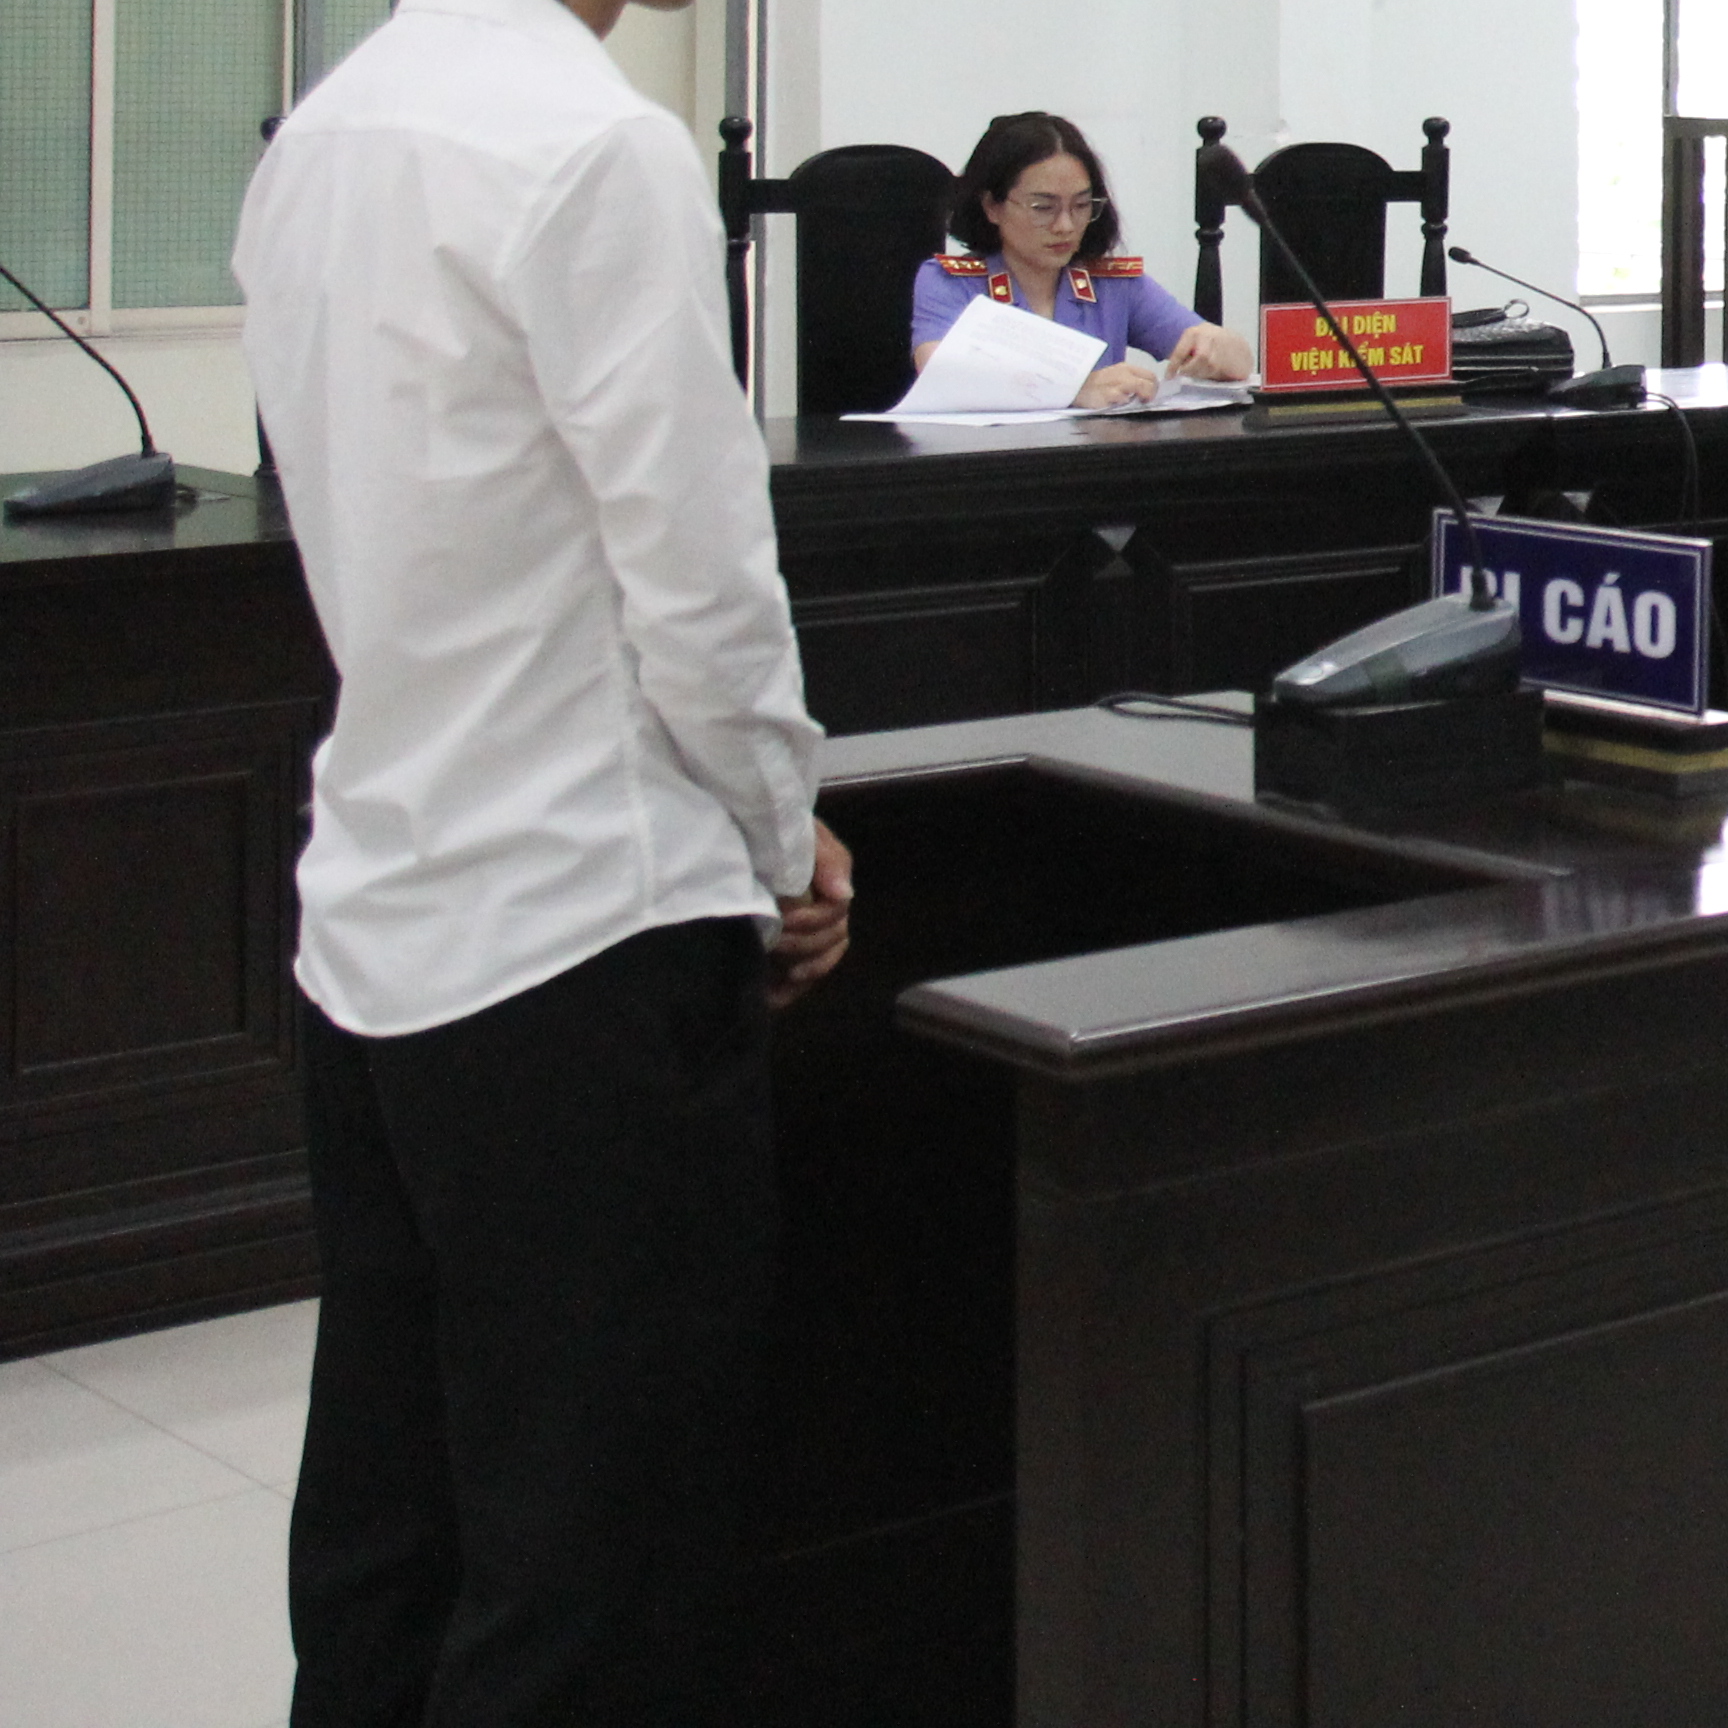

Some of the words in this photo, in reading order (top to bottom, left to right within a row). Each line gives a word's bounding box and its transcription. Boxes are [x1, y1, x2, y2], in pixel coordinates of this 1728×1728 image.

[1353, 311, 1397, 339] DIỆN
[1291, 347, 1334, 375] VIỆN
[1389, 343, 1424, 366] SÁT
[1543, 572, 1677, 659] CÁO
